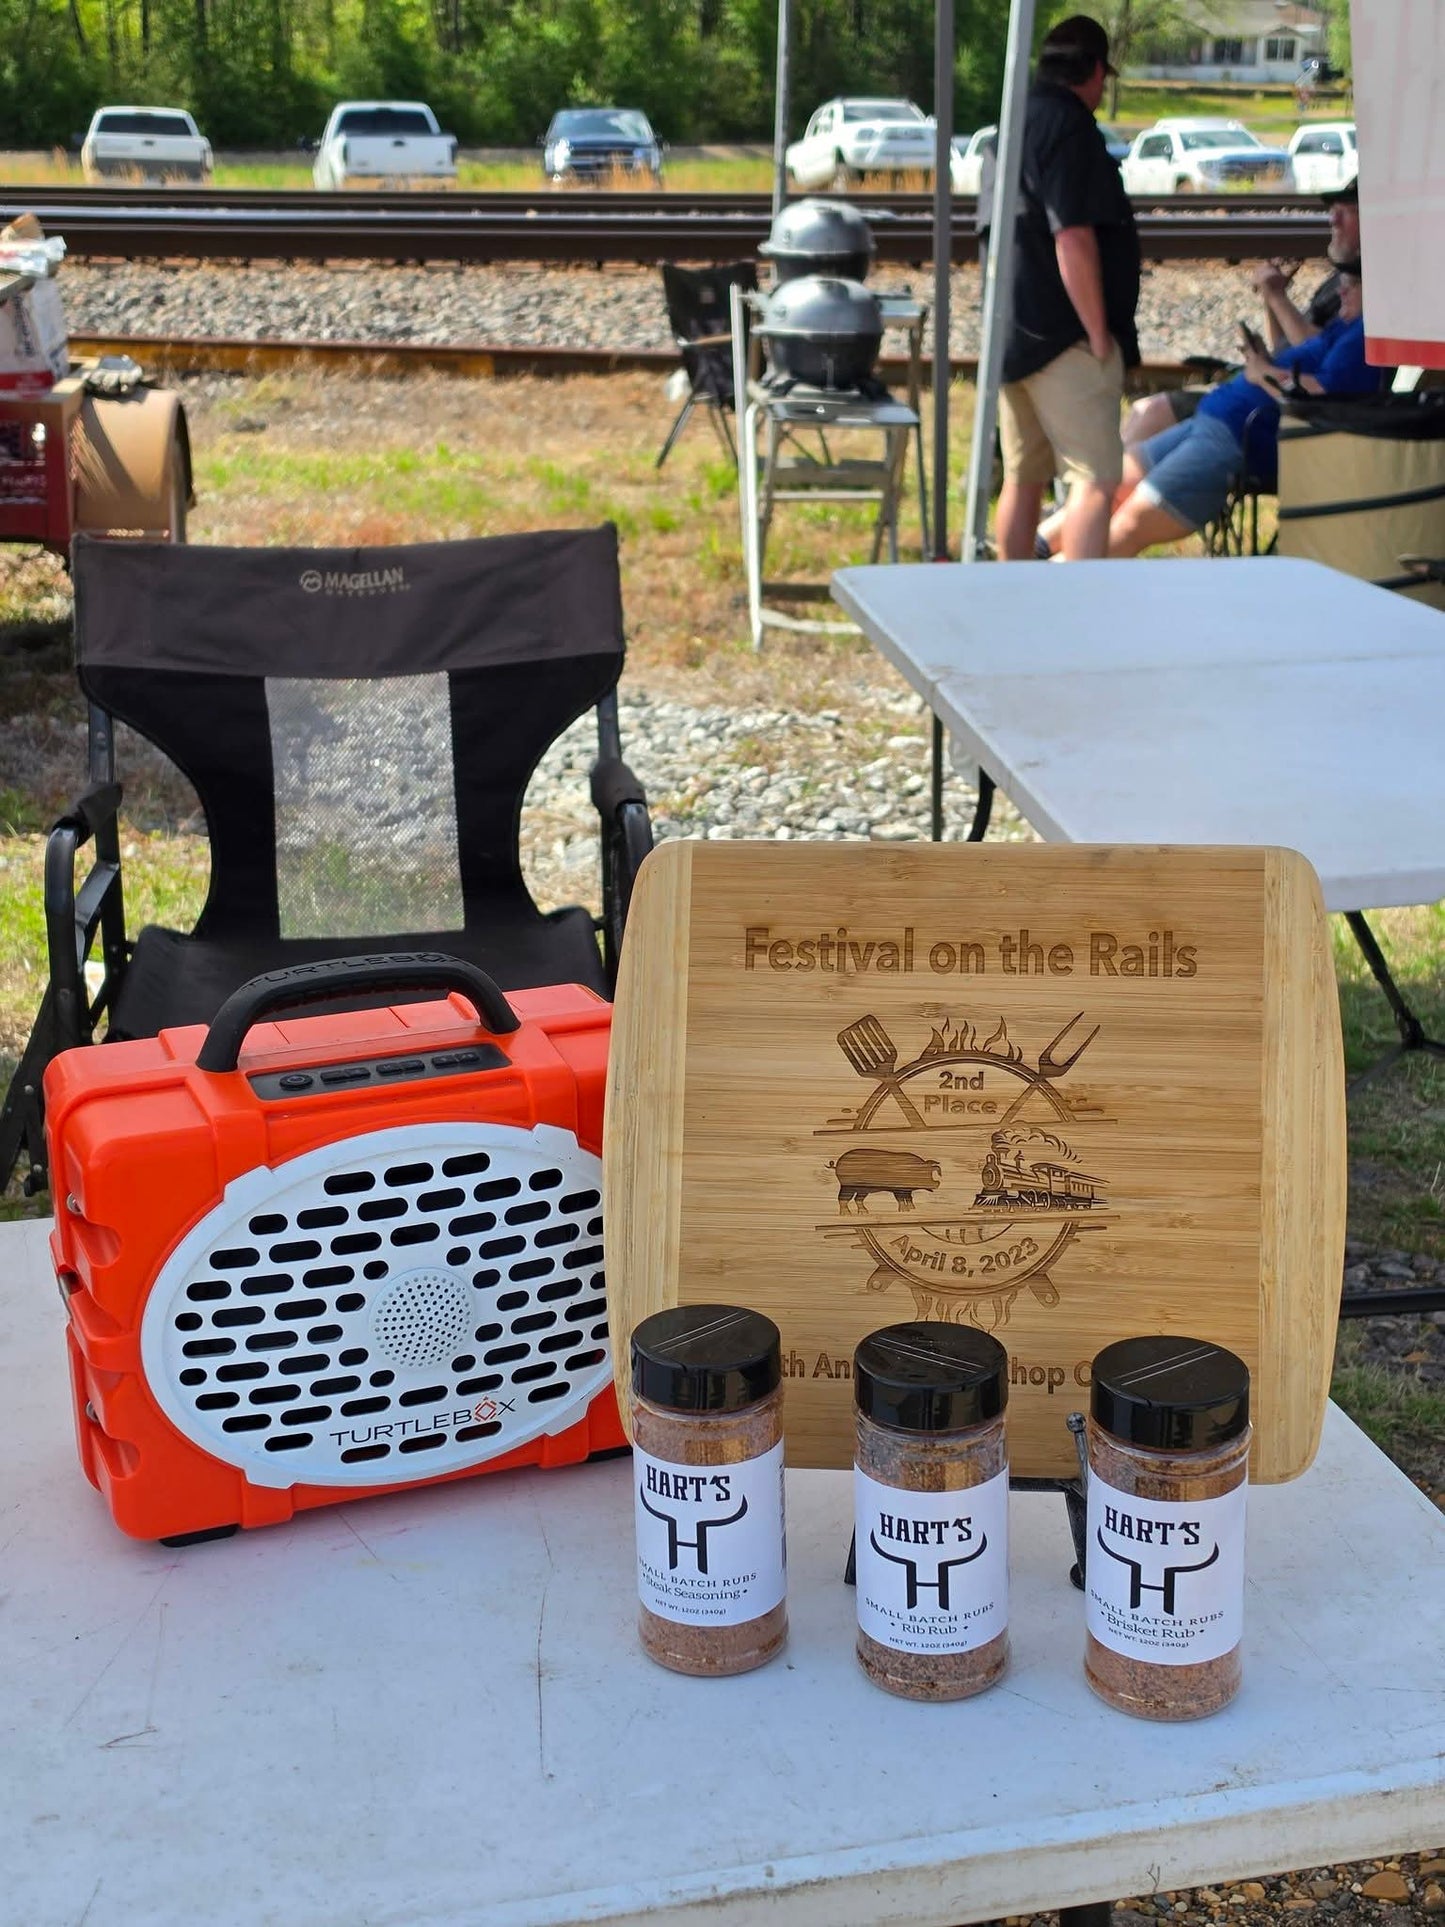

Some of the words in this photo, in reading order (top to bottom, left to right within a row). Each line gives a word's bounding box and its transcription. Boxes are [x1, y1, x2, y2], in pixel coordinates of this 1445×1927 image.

[324, 565, 404, 590] MAGELLAN
[744, 926, 914, 974] Festival
[928, 939, 986, 976] on
[999, 929, 1074, 977] the
[1089, 931, 1198, 979] Rails
[939, 1071, 984, 1091] 2nd
[924, 1095, 997, 1115] Place
[889, 1234, 948, 1272] April
[951, 1256, 974, 1278] 8,
[979, 1236, 1040, 1274] 2023
[780, 1350, 805, 1378] th
[1007, 1356, 1066, 1395] hop
[329, 1396, 517, 1447] TURTLEBOX
[646, 1464, 731, 1502] HART'S
[880, 1512, 972, 1545] HART'S
[1105, 1504, 1201, 1546] HART'S
[671, 1575, 717, 1588] BATCH
[722, 1572, 758, 1588] RUBS
[655, 1598, 667, 1608] NET
[674, 1587, 741, 1601] Seasoning
[1090, 1588, 1127, 1617] SMALL
[1131, 1613, 1184, 1627] BATCH
[1189, 1610, 1225, 1626] RUBS
[865, 1597, 904, 1620] SMALL
[908, 1614, 958, 1624] BATCH
[964, 1601, 995, 1621] RUBS
[902, 1623, 926, 1636] Rib
[928, 1623, 958, 1636] Rub
[1107, 1612, 1158, 1637] Brisket
[1161, 1628, 1196, 1639] Rub
[1108, 1627, 1123, 1637] NET
[889, 1636, 904, 1645] NET
